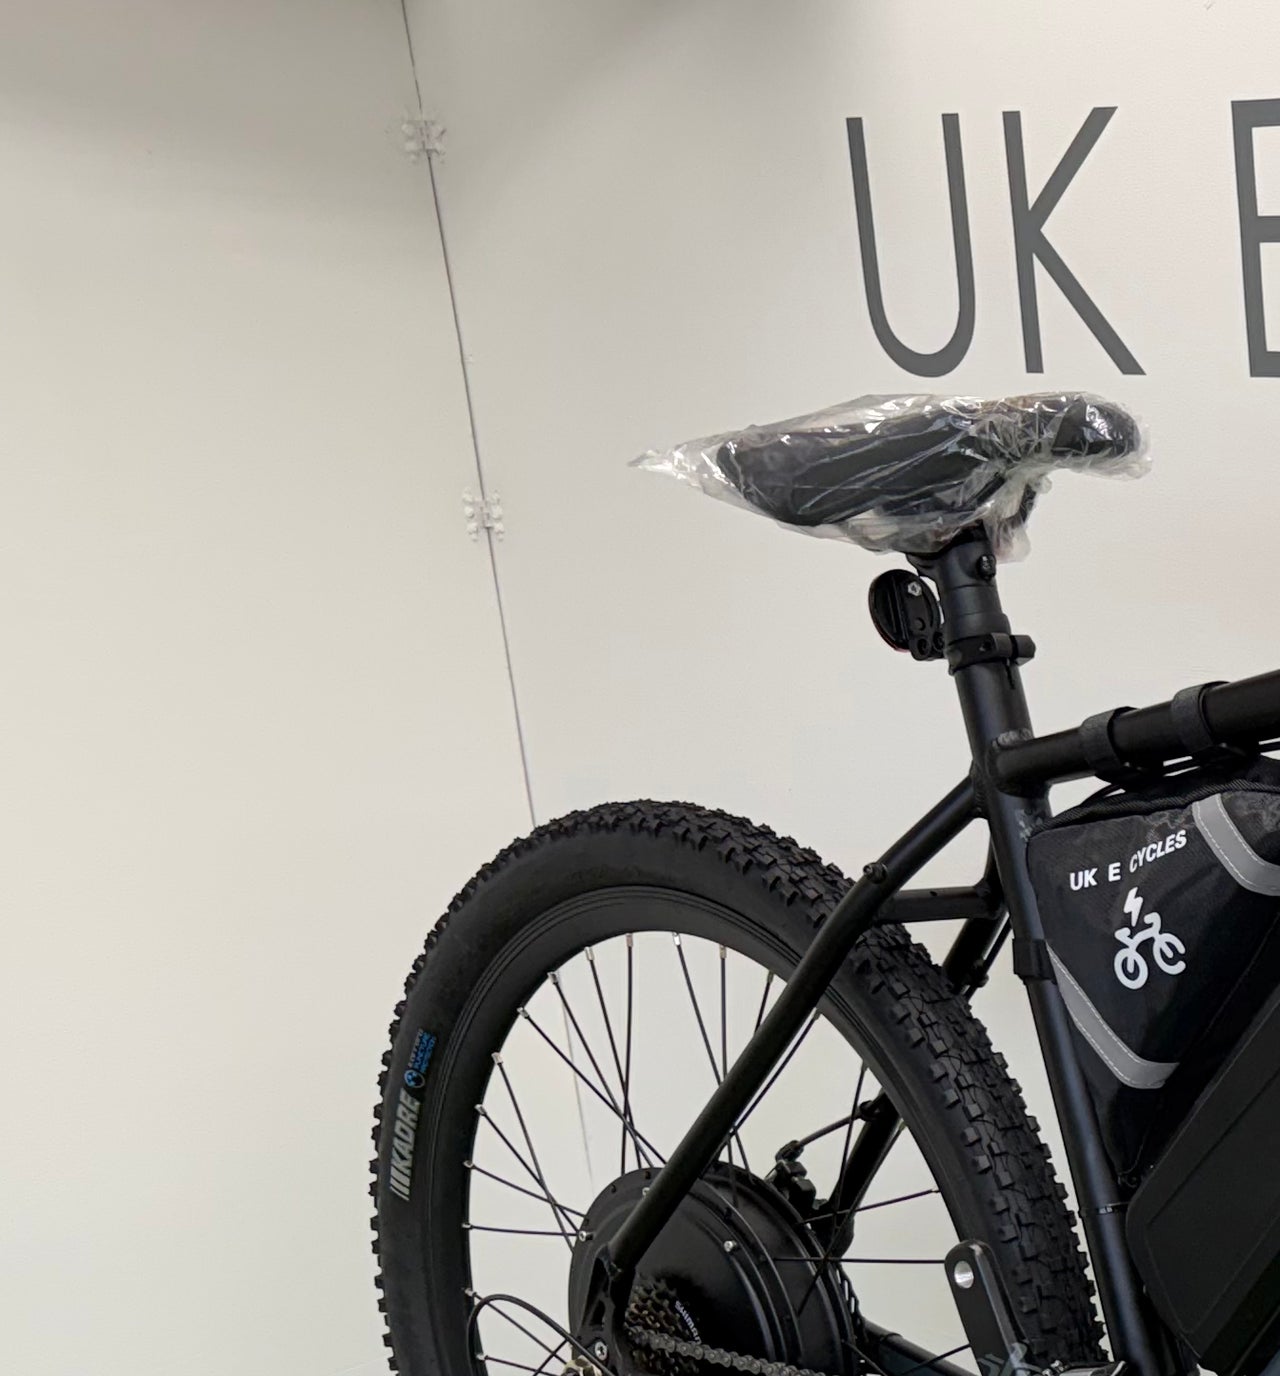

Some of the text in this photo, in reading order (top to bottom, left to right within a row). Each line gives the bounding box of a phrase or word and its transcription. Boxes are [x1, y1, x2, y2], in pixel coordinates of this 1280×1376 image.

[846, 106, 1147, 378] UK
[1069, 829, 1187, 891] UK E CYCLES
[674, 1299, 703, 1346] SHIMAN
